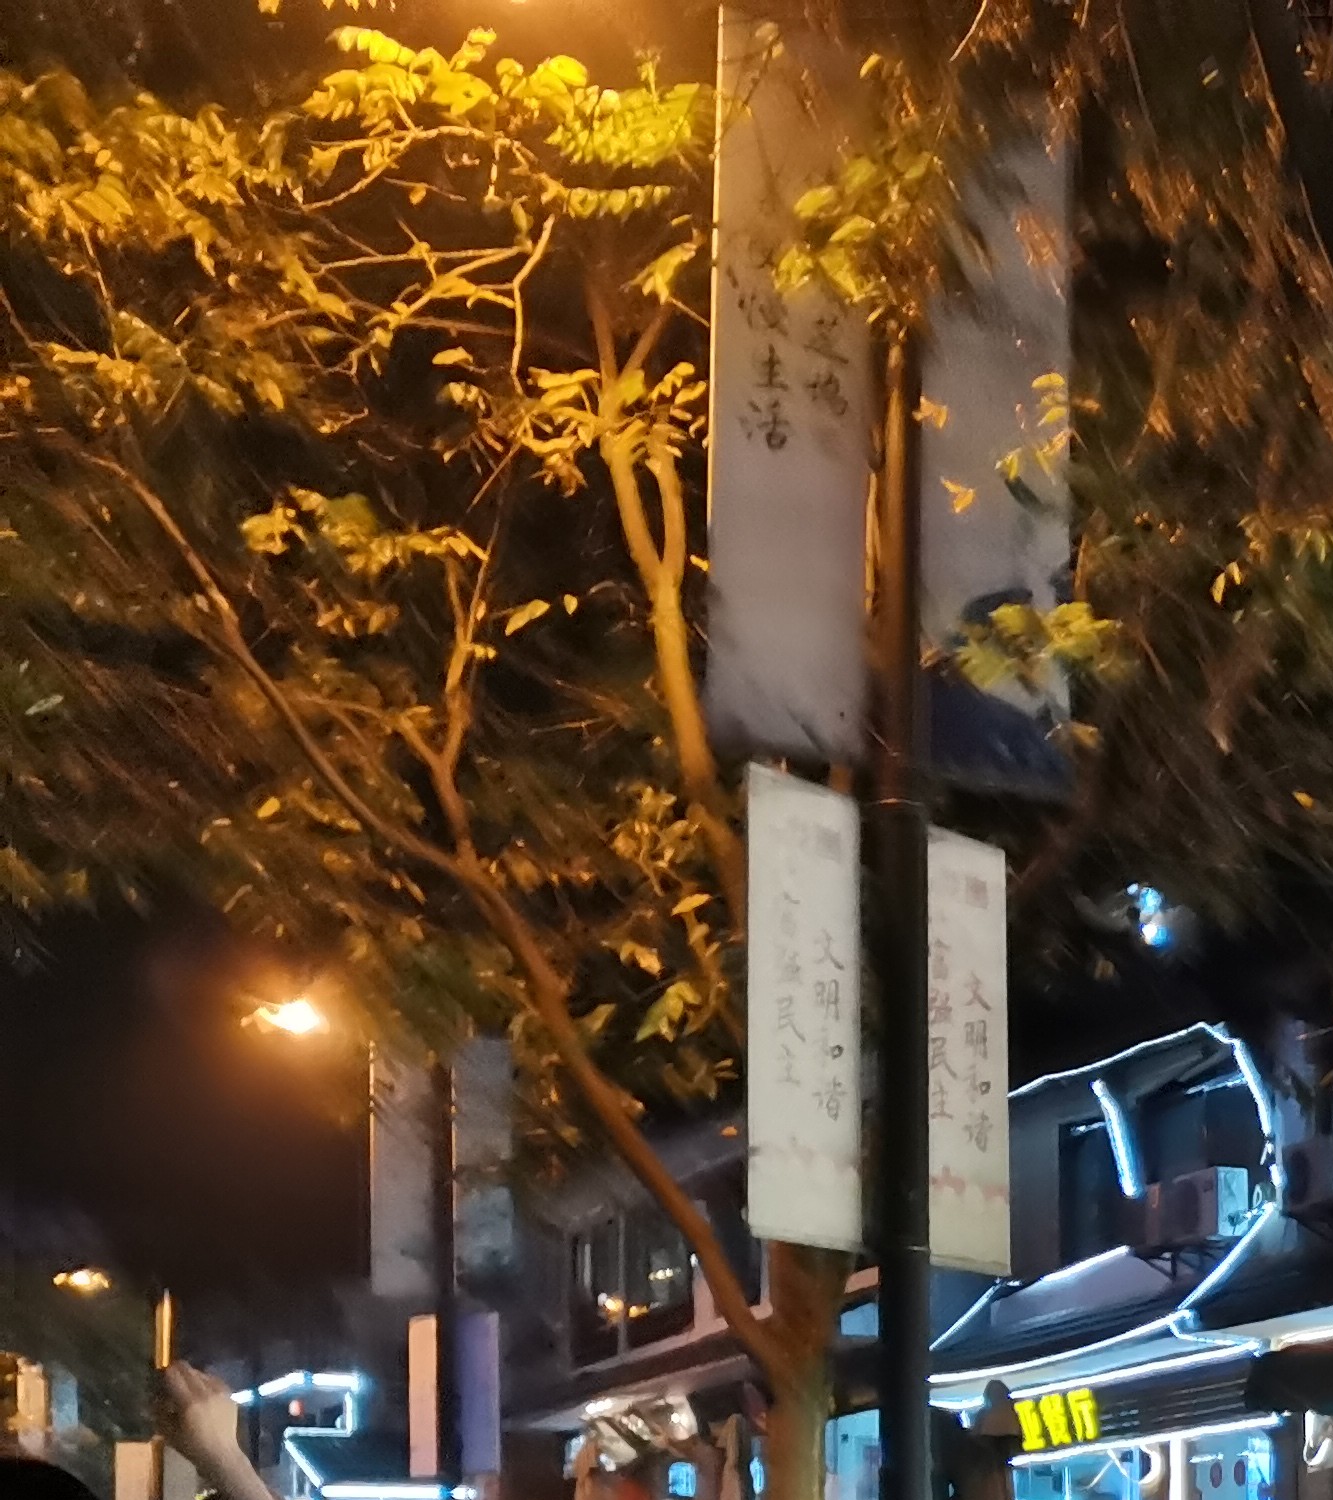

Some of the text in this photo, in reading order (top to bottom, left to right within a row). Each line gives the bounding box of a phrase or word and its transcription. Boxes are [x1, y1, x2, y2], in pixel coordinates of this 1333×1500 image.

[812, 929, 849, 1123] 文明和谐
[962, 970, 994, 1153] 文明和谐
